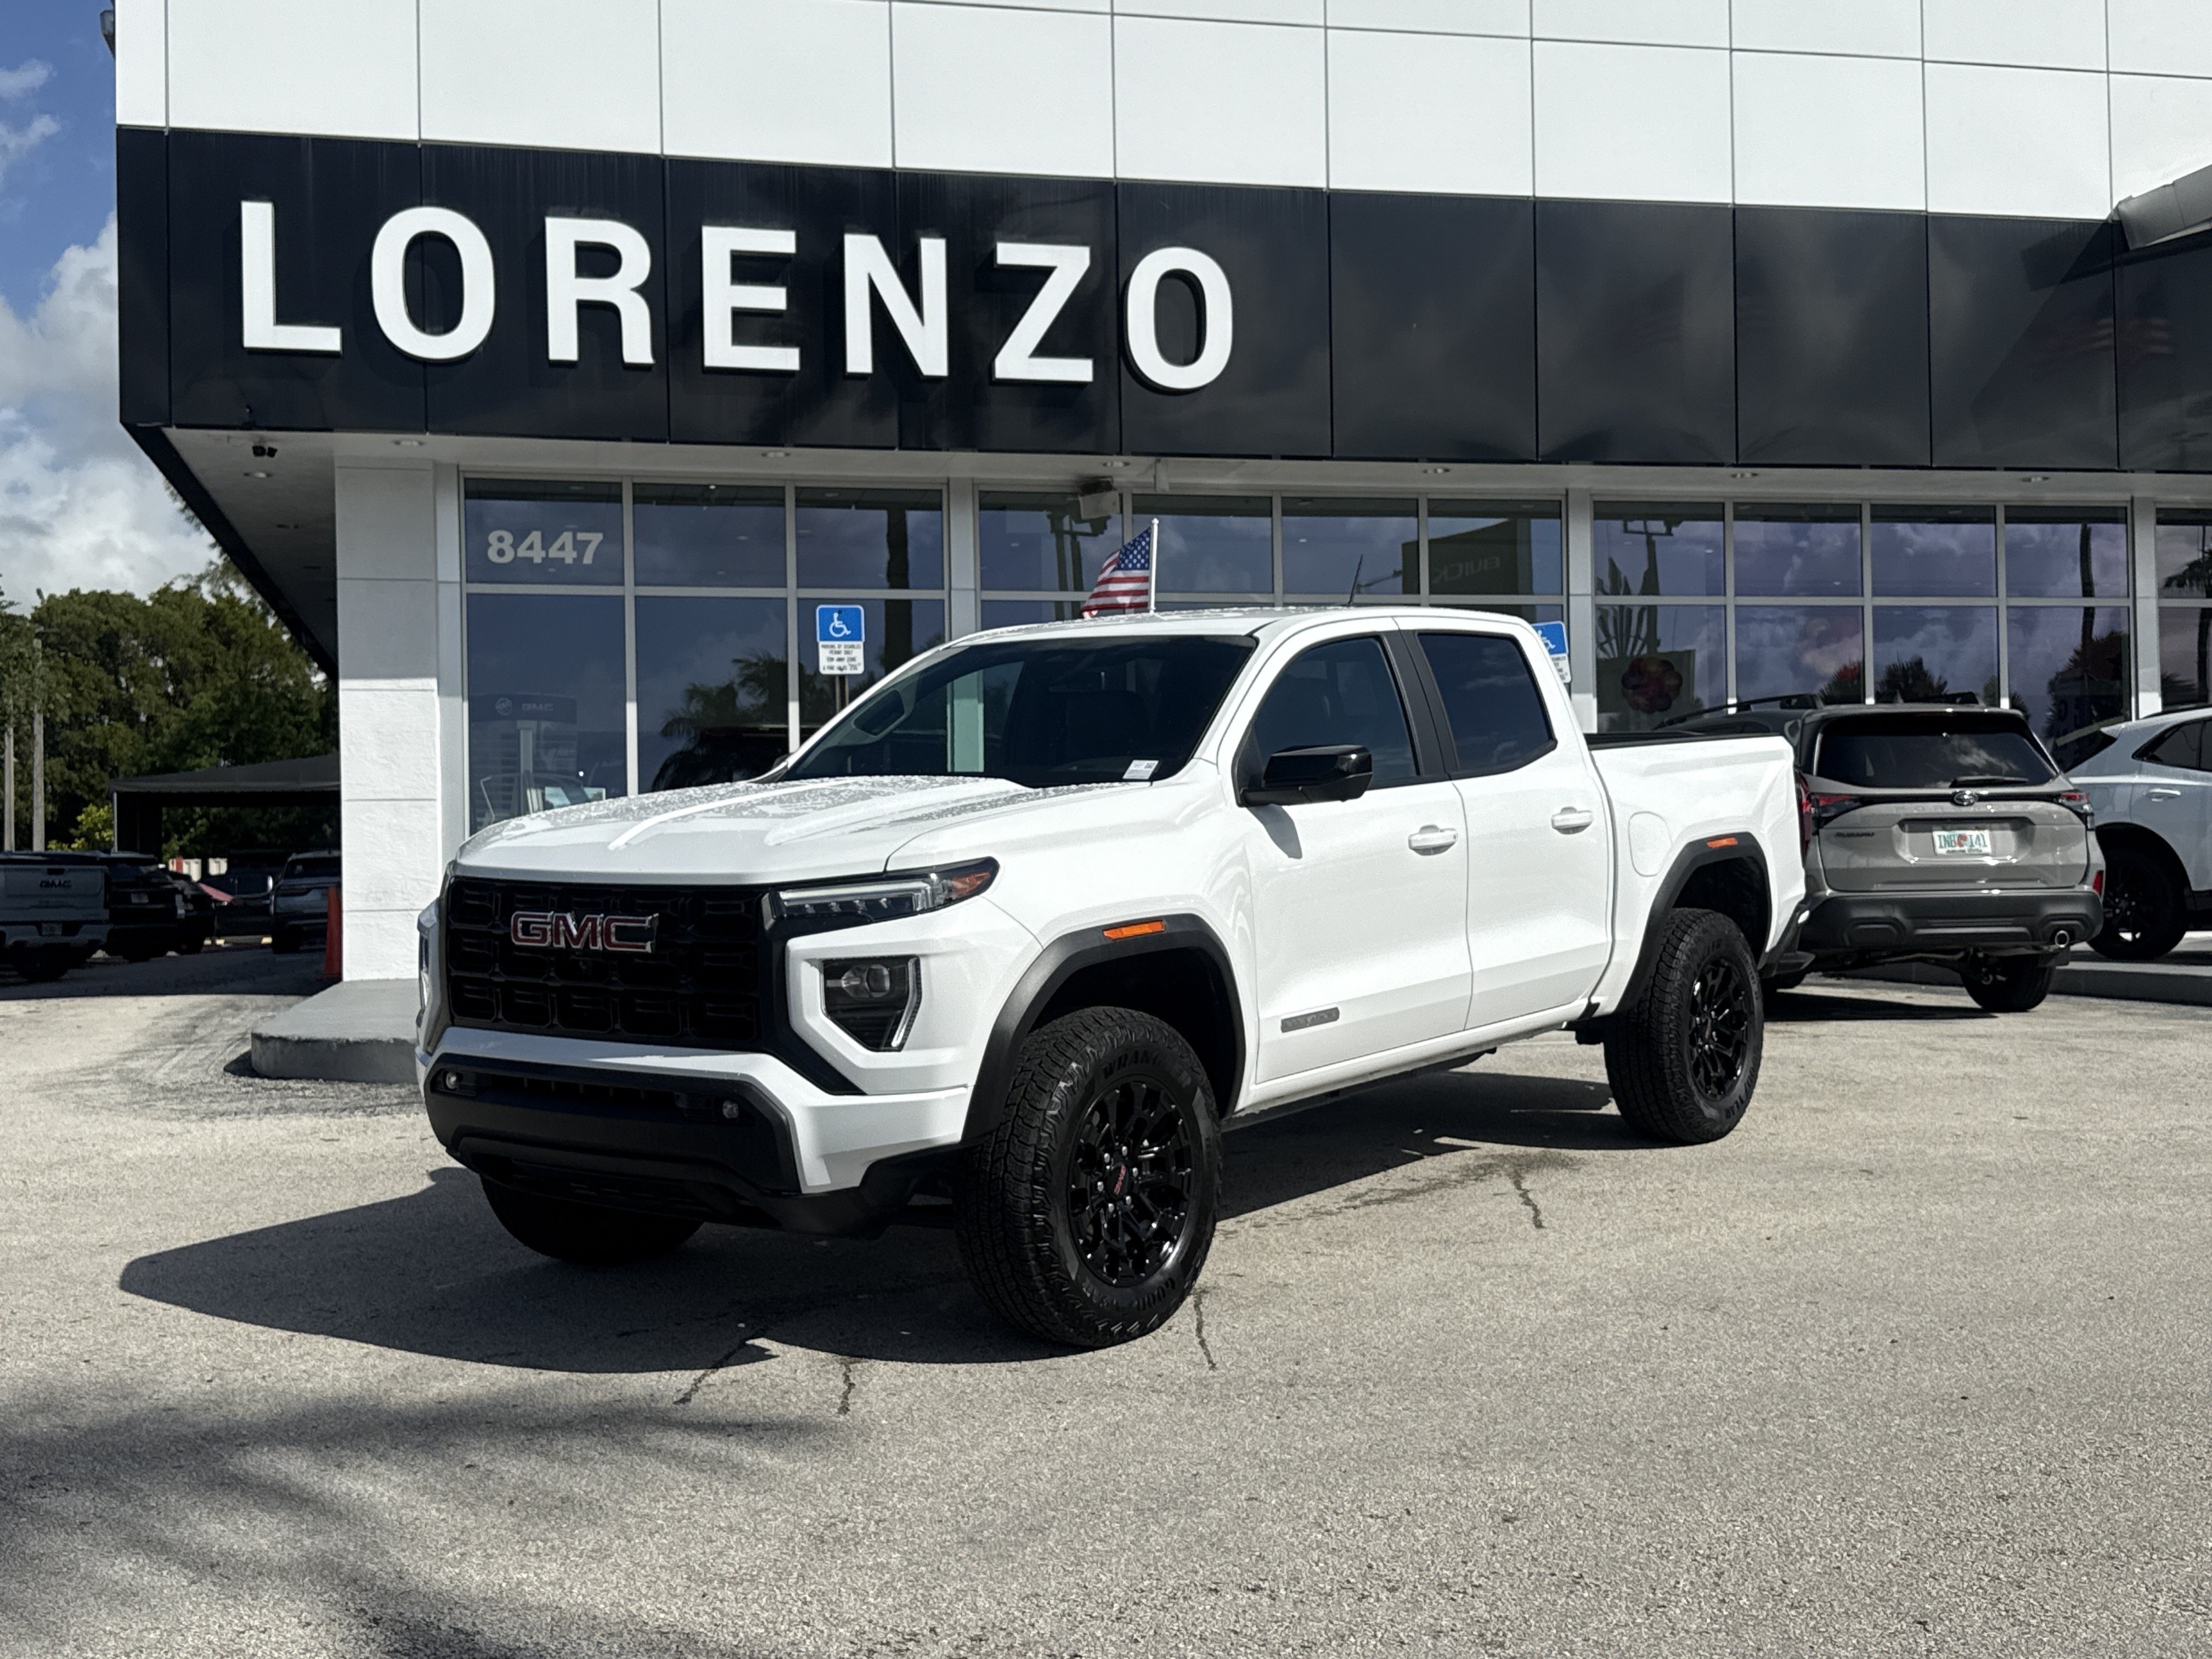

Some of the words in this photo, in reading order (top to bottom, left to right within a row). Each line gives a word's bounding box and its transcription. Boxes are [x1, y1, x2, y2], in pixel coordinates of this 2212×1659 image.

[241, 200, 1233, 390] LORENZO
[487, 530, 603, 565] 8447
[40, 880, 72, 888] GMC
[511, 911, 659, 953] GMC
[1102, 1048, 1192, 1089] WRANGER
